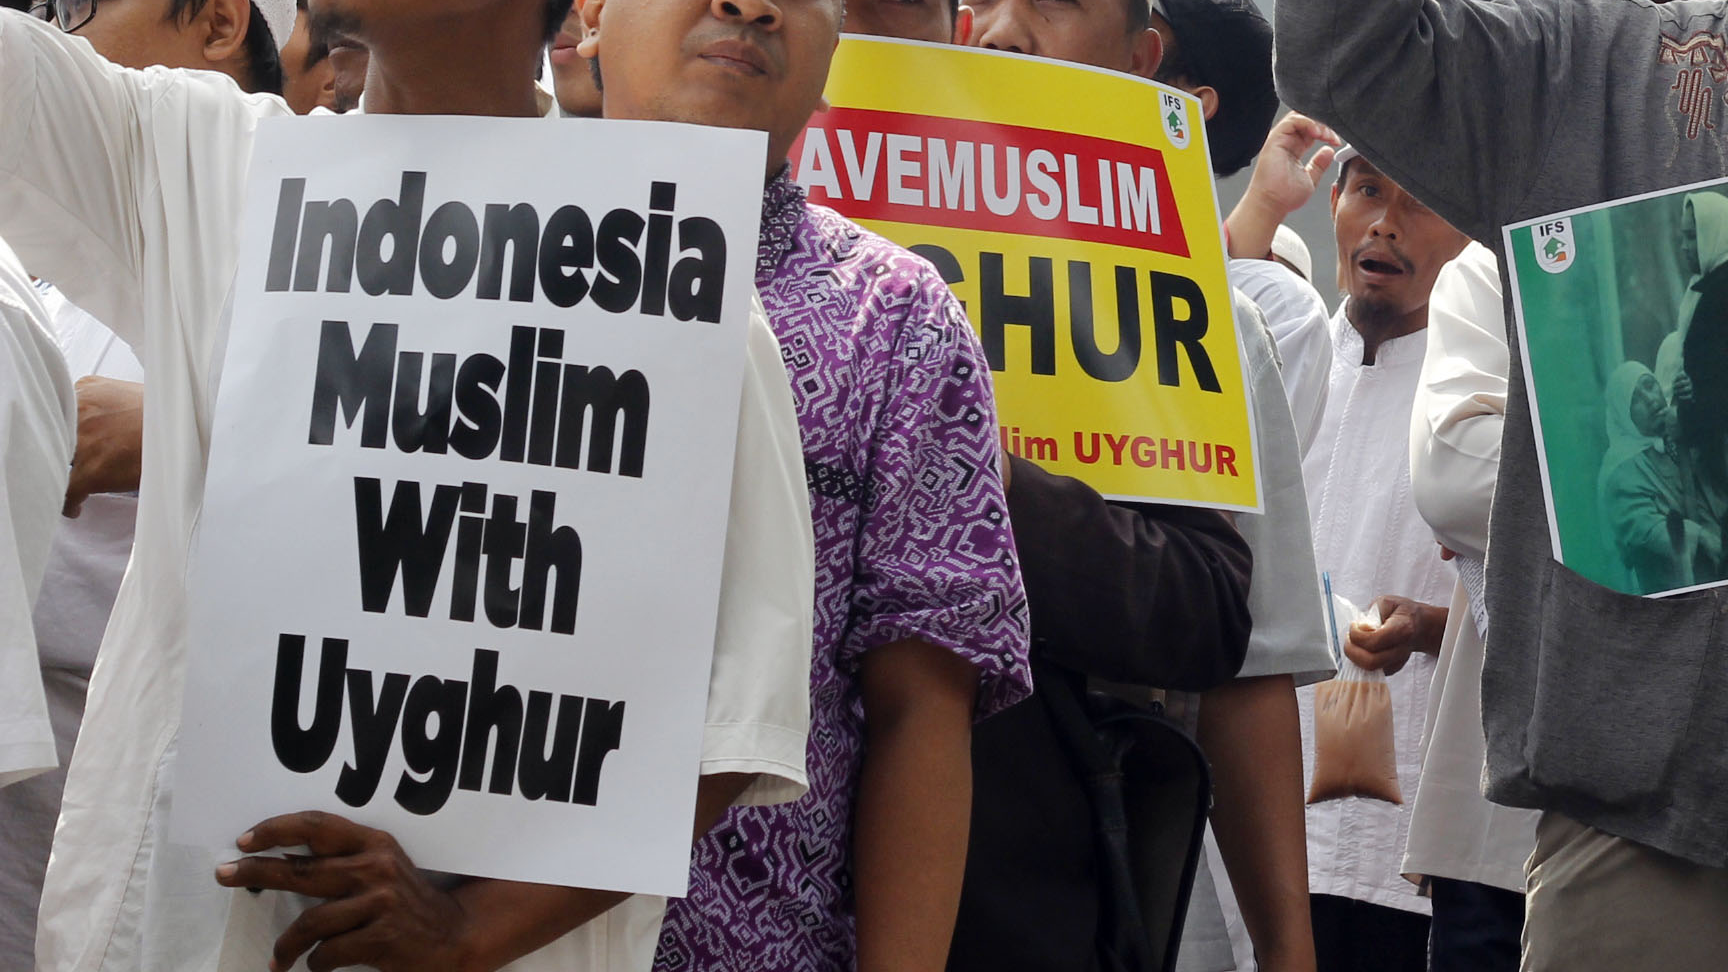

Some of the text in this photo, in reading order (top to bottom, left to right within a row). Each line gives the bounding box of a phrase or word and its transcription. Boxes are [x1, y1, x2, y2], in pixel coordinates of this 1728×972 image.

[1163, 93, 1182, 111] IFS
[796, 127, 1162, 235] AVEMUSLIM
[1539, 221, 1565, 237] IFS
[265, 171, 727, 324] Indonesia
[308, 320, 650, 478] Muslim
[1000, 426, 1238, 477] lim UYGHUR
[354, 476, 582, 635] With
[271, 633, 626, 815] Uyghur
